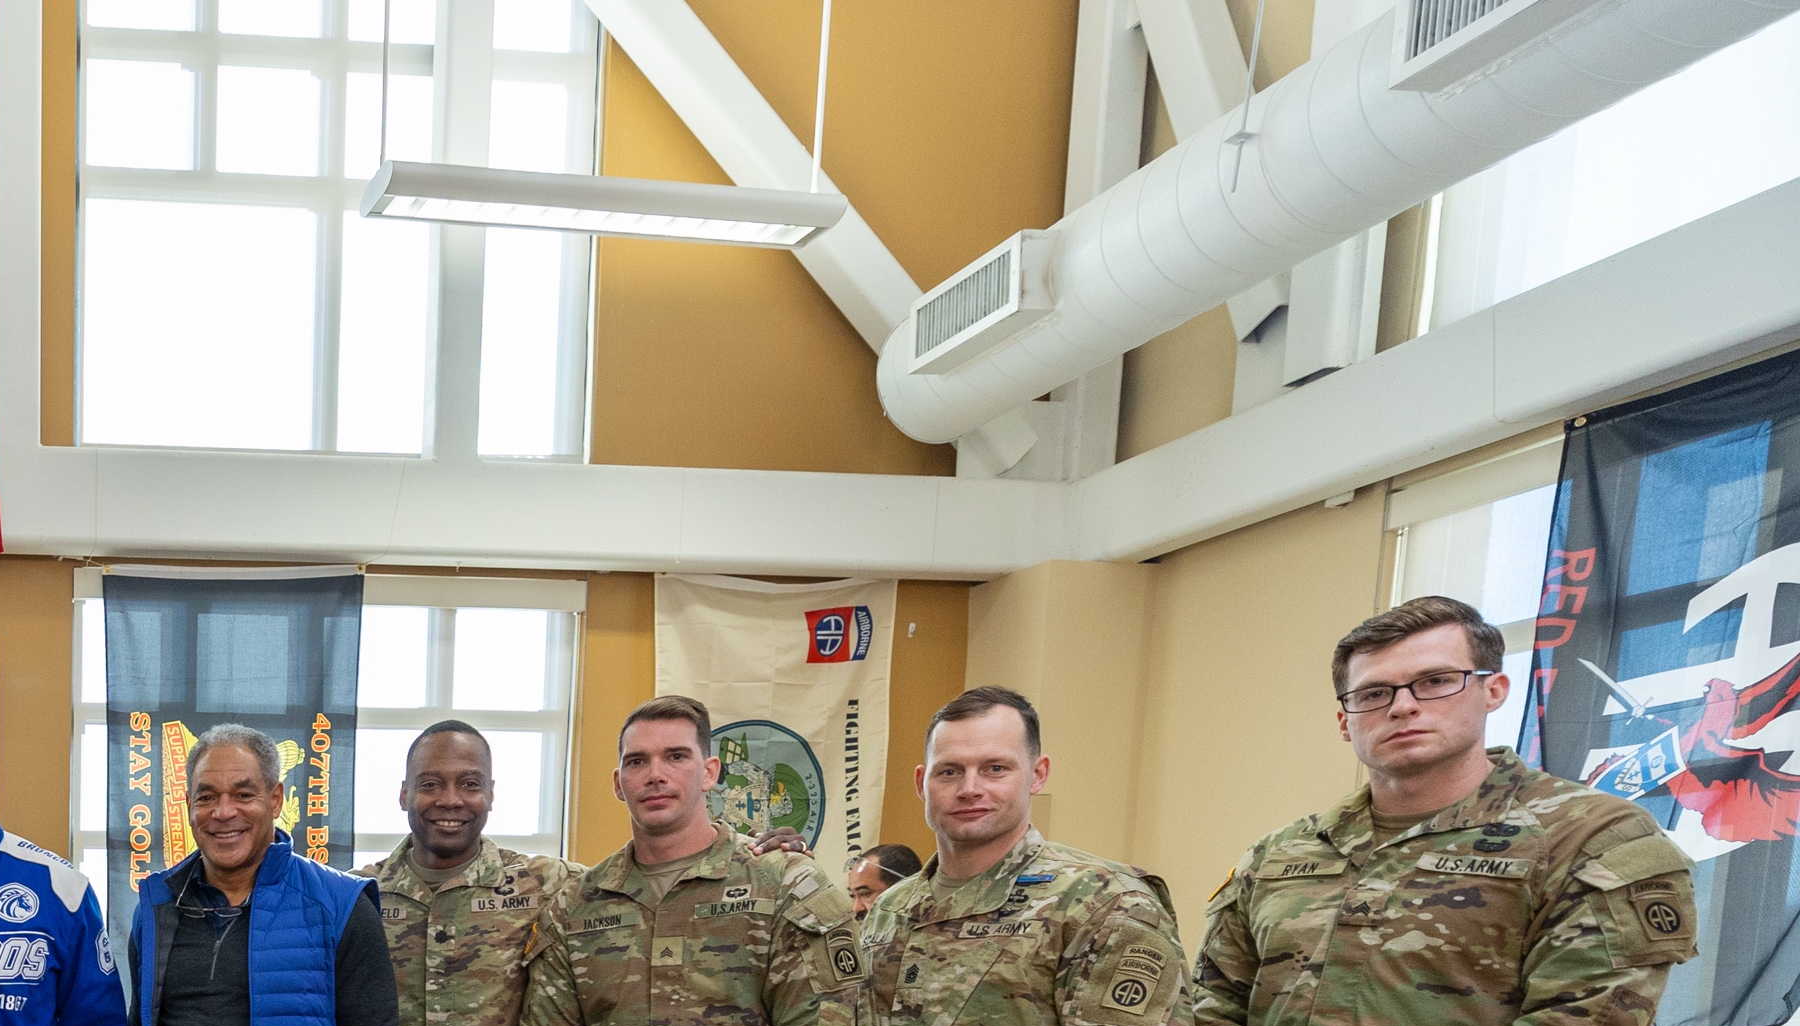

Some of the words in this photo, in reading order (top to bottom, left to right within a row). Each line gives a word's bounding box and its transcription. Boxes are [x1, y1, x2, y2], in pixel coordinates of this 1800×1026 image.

[1535, 547, 1597, 650] RED
[857, 611, 871, 656] AIRBORNE
[130, 712, 151, 796] STAY
[167, 726, 187, 779] SUPPLY
[308, 712, 331, 817] 407TH
[845, 699, 860, 803] FIGHTING
[172, 786, 185, 799] IS
[129, 804, 151, 892] GOLD
[1281, 862, 1320, 876] RYAN
[478, 899, 498, 910] U.S.
[501, 897, 531, 909] ARMY
[583, 915, 622, 930] JACKSON
[993, 923, 1031, 935] ARMY
[1121, 960, 1159, 976] AIRBORNE
[1129, 947, 1163, 963] RANGER
